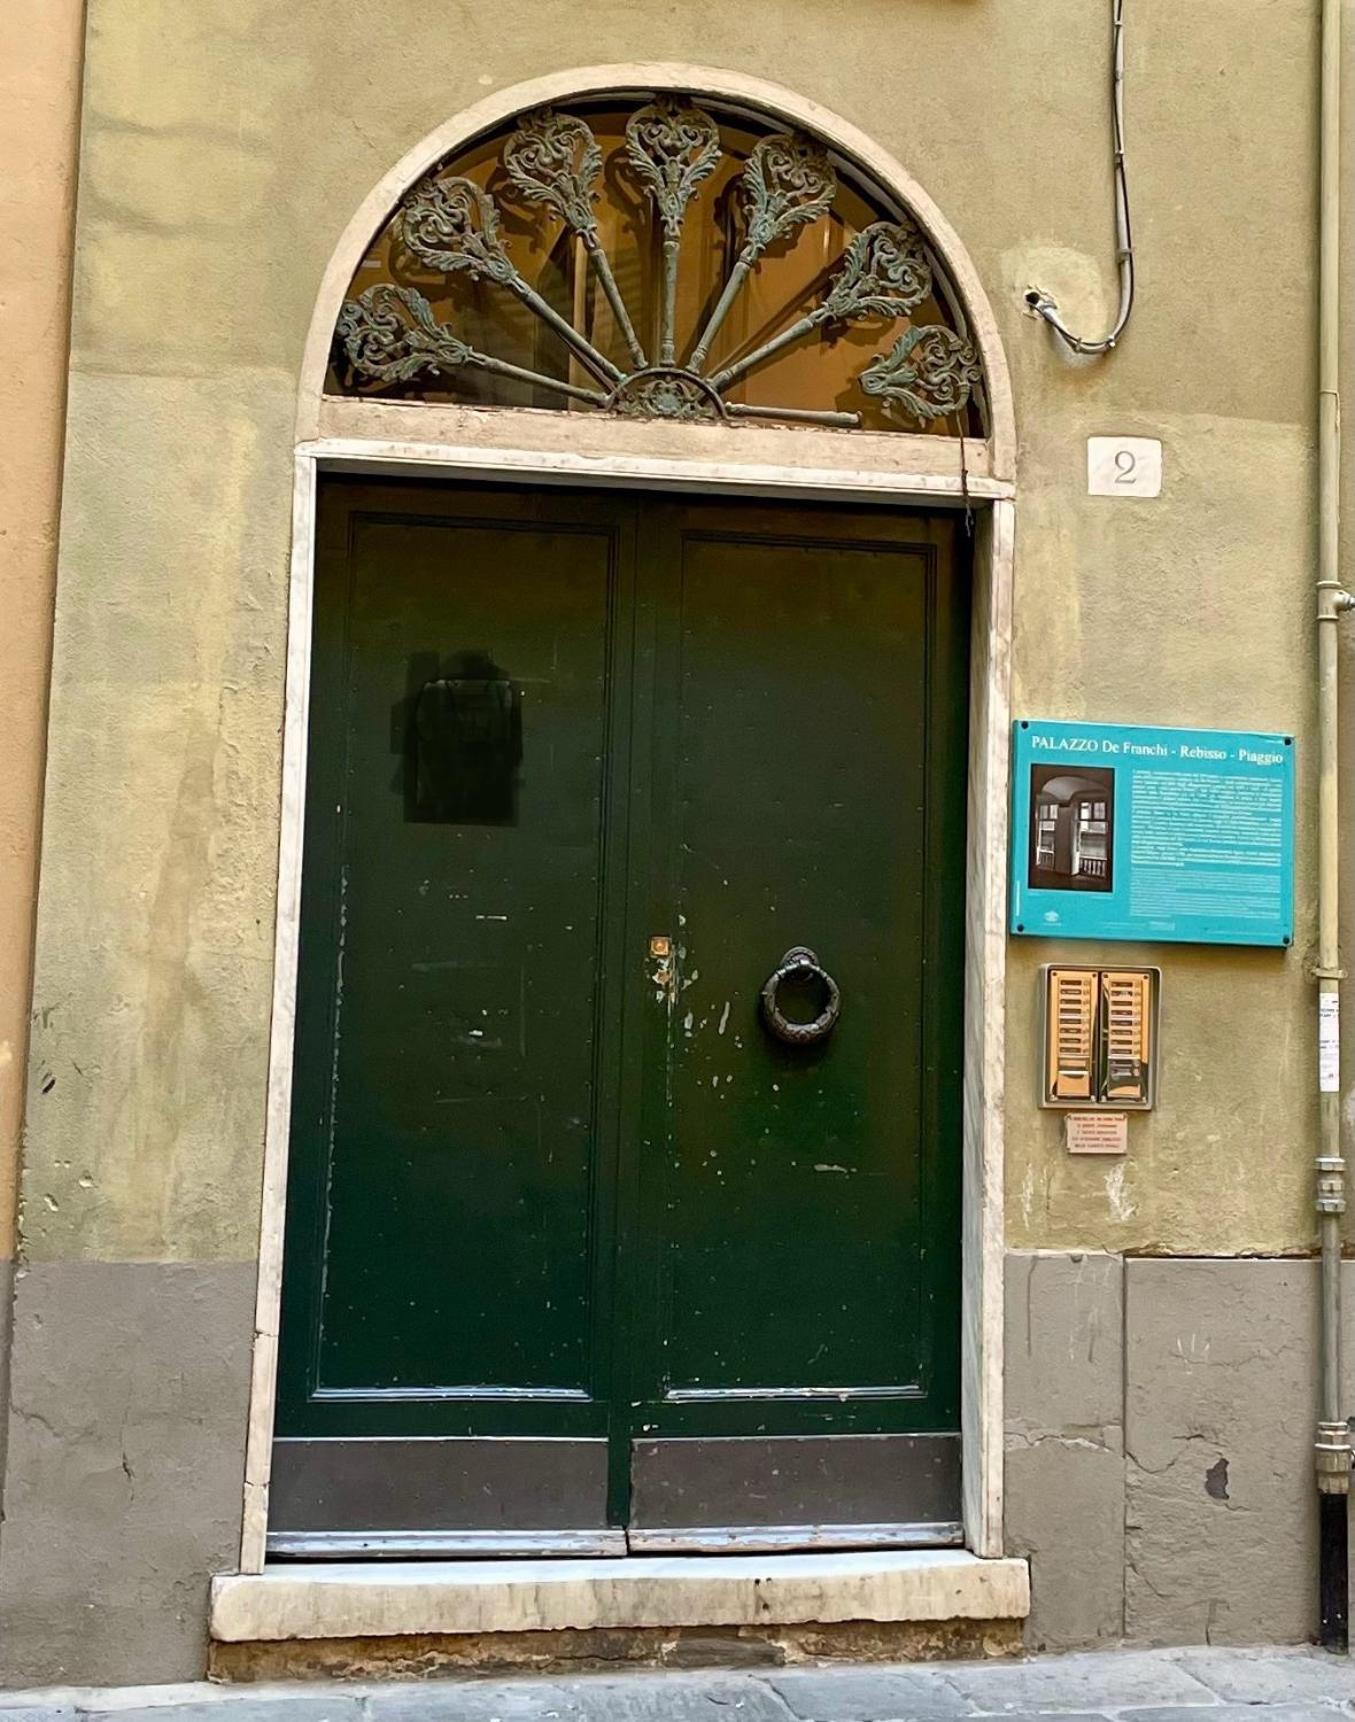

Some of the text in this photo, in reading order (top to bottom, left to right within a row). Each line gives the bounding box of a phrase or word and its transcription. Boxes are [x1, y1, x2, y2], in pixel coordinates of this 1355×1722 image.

[1114, 450, 1137, 484] 2
[1031, 735, 1099, 752] PALAZZO
[1102, 740, 1120, 753] De
[1123, 742, 1168, 757] Franchi
[1179, 745, 1227, 760] Rebisso
[1238, 748, 1284, 766] Piaggio
